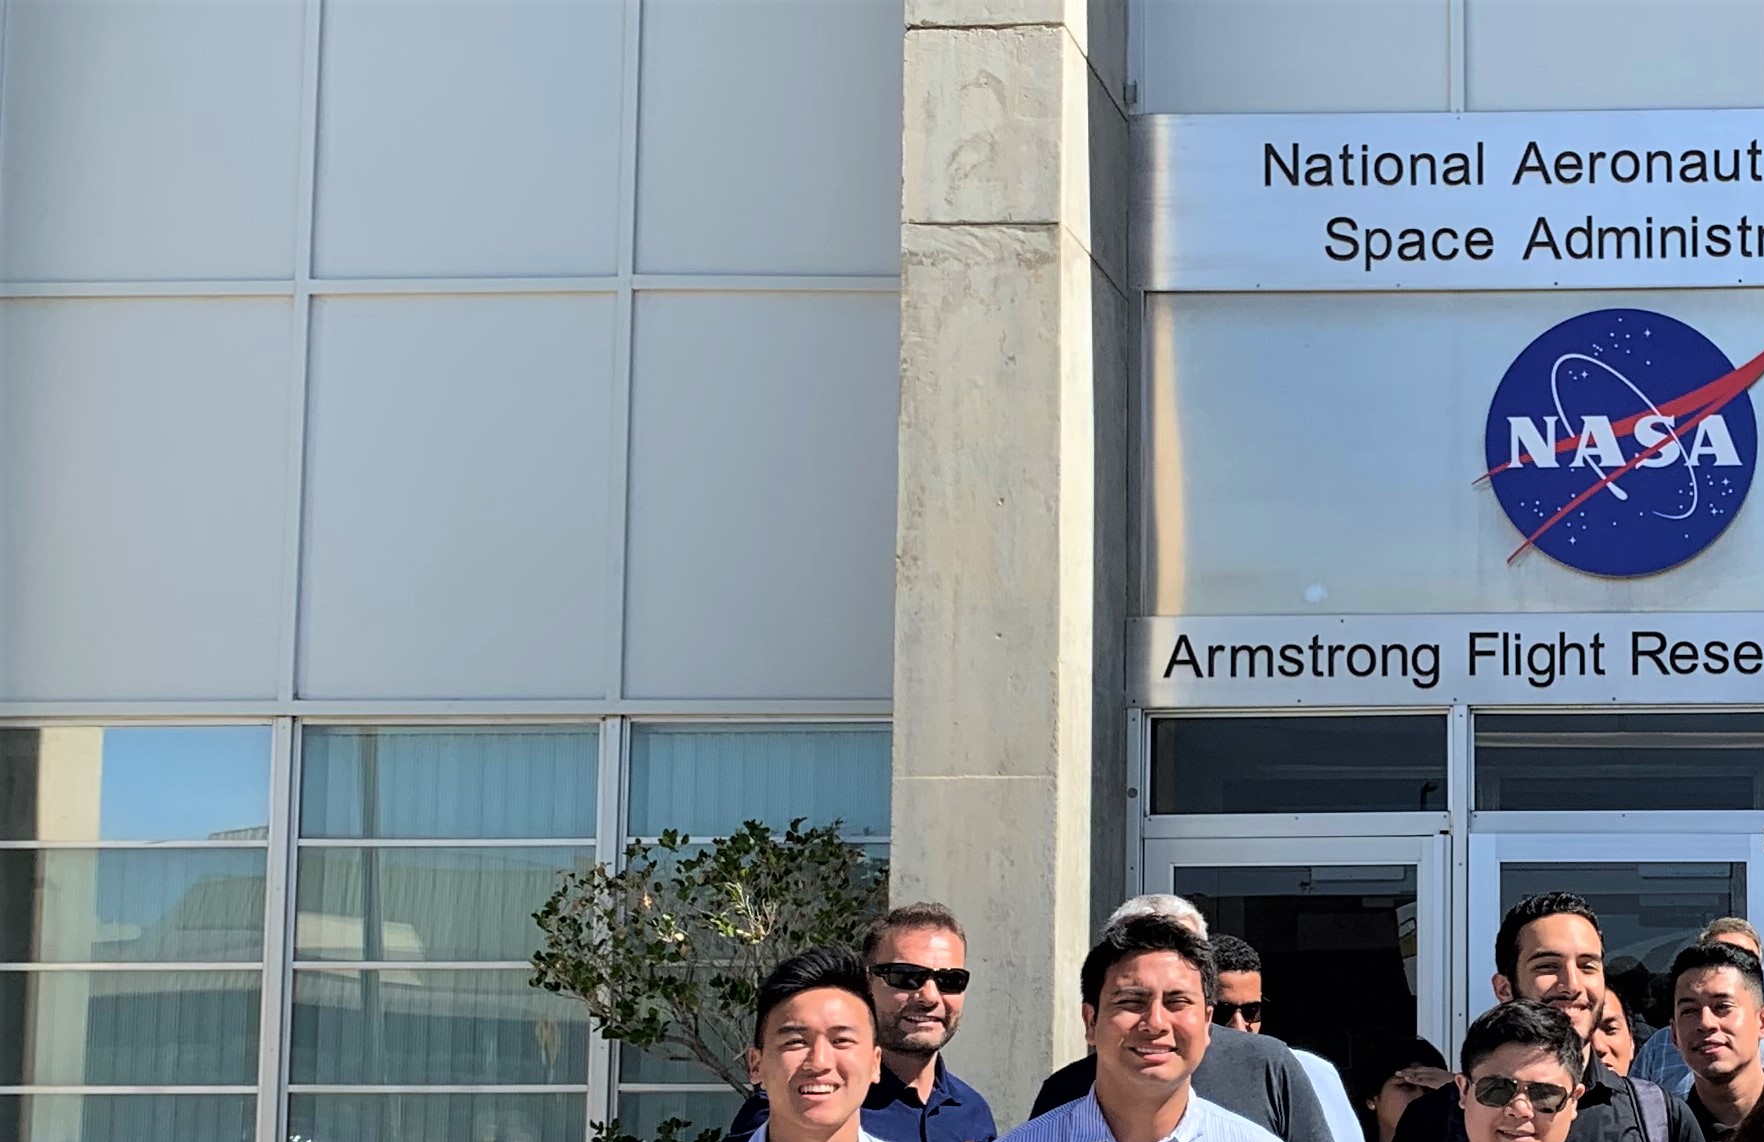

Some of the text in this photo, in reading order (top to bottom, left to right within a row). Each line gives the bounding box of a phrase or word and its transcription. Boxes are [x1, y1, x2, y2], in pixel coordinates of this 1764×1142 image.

[1263, 140, 1485, 188] National
[1323, 216, 1494, 272] Space
[1506, 413, 1743, 469] NASA
[1163, 633, 1441, 689] Armstrong
[1468, 630, 1606, 689] Flight
